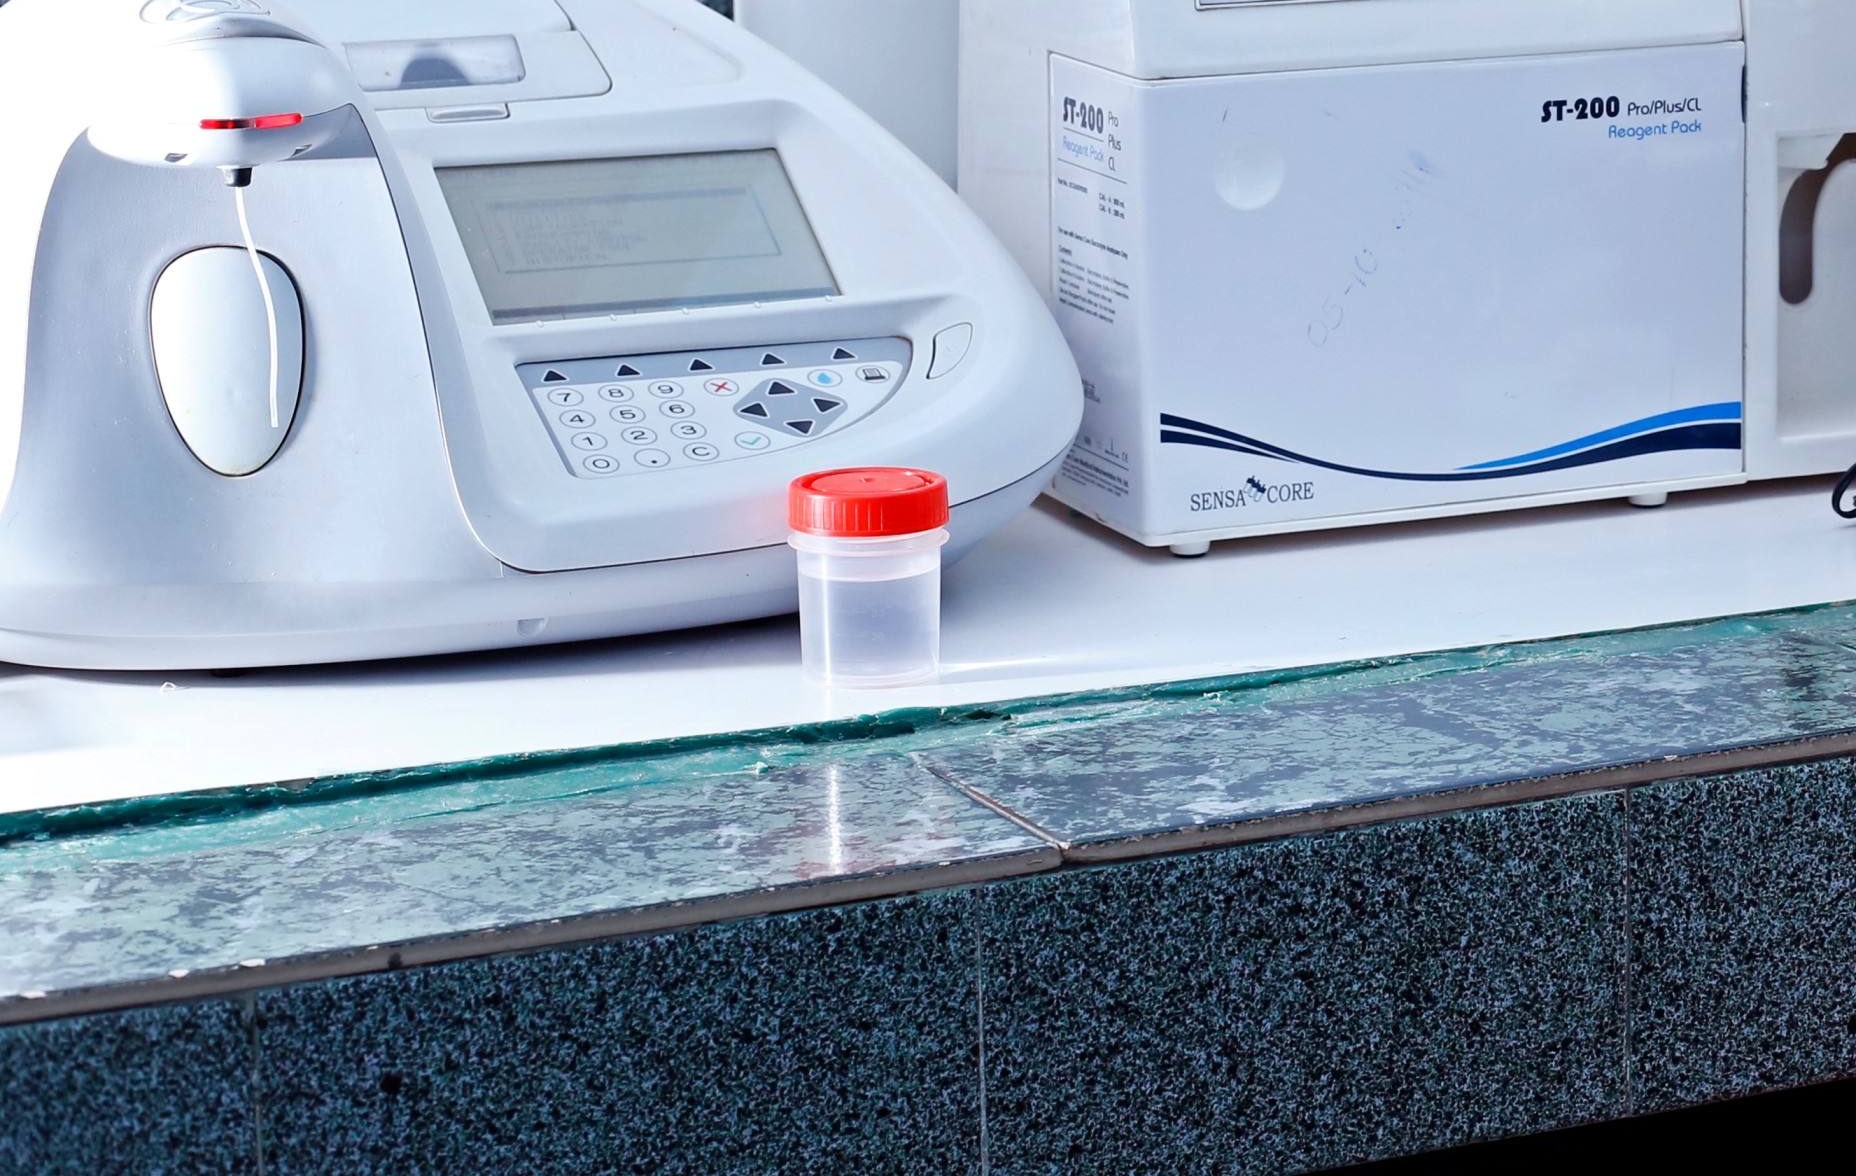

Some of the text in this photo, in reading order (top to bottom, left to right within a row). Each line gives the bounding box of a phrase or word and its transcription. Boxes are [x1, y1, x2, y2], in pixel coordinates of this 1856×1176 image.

[1063, 96, 1119, 134] ST-200 Pro
[1541, 96, 1702, 123] ST-200 Pro/Plus/CL
[1608, 119, 1702, 140] Reagent Pack
[1063, 135, 1104, 162] Reagent Pack
[1108, 134, 1122, 151] Plus
[1108, 156, 1116, 171] CL
[557, 385, 674, 402] 7 8 9
[569, 404, 685, 423] 4 5 6
[582, 425, 697, 446] 1 2 3
[692, 446, 710, 456] C
[1190, 482, 1314, 511] SENSA CORE
